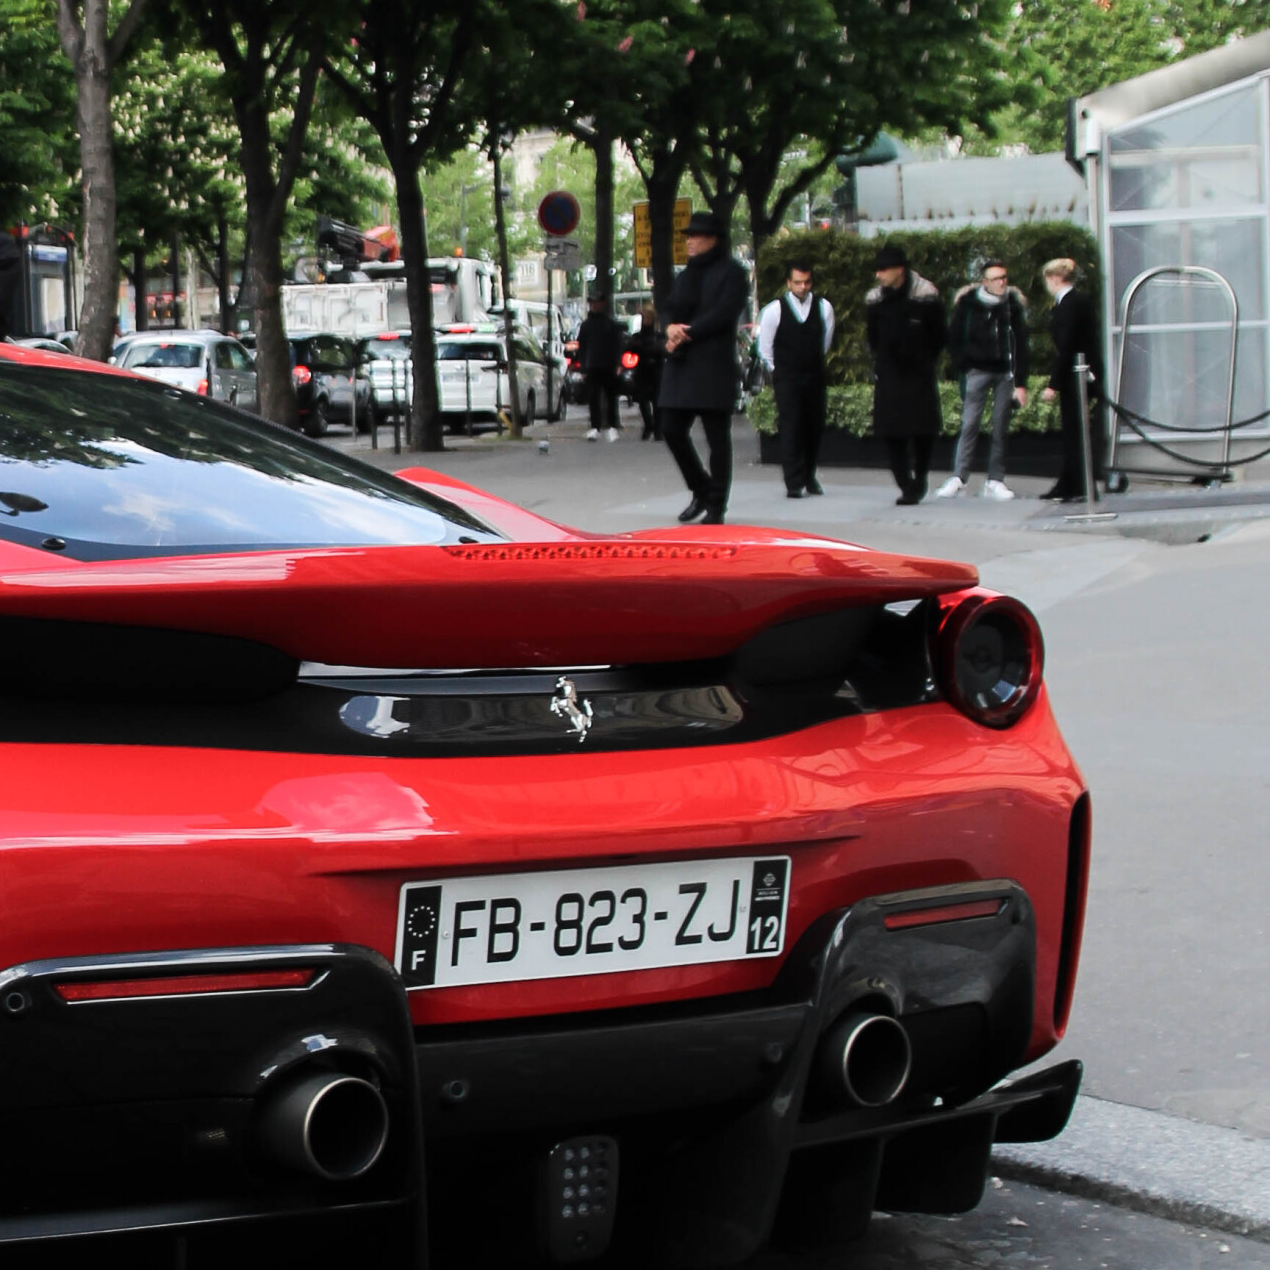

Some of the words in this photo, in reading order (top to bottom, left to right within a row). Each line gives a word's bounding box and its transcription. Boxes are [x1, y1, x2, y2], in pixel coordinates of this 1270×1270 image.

[450, 879, 741, 967] FB-823-ZJ
[750, 915, 779, 950] 12
[411, 950, 426, 971] F
